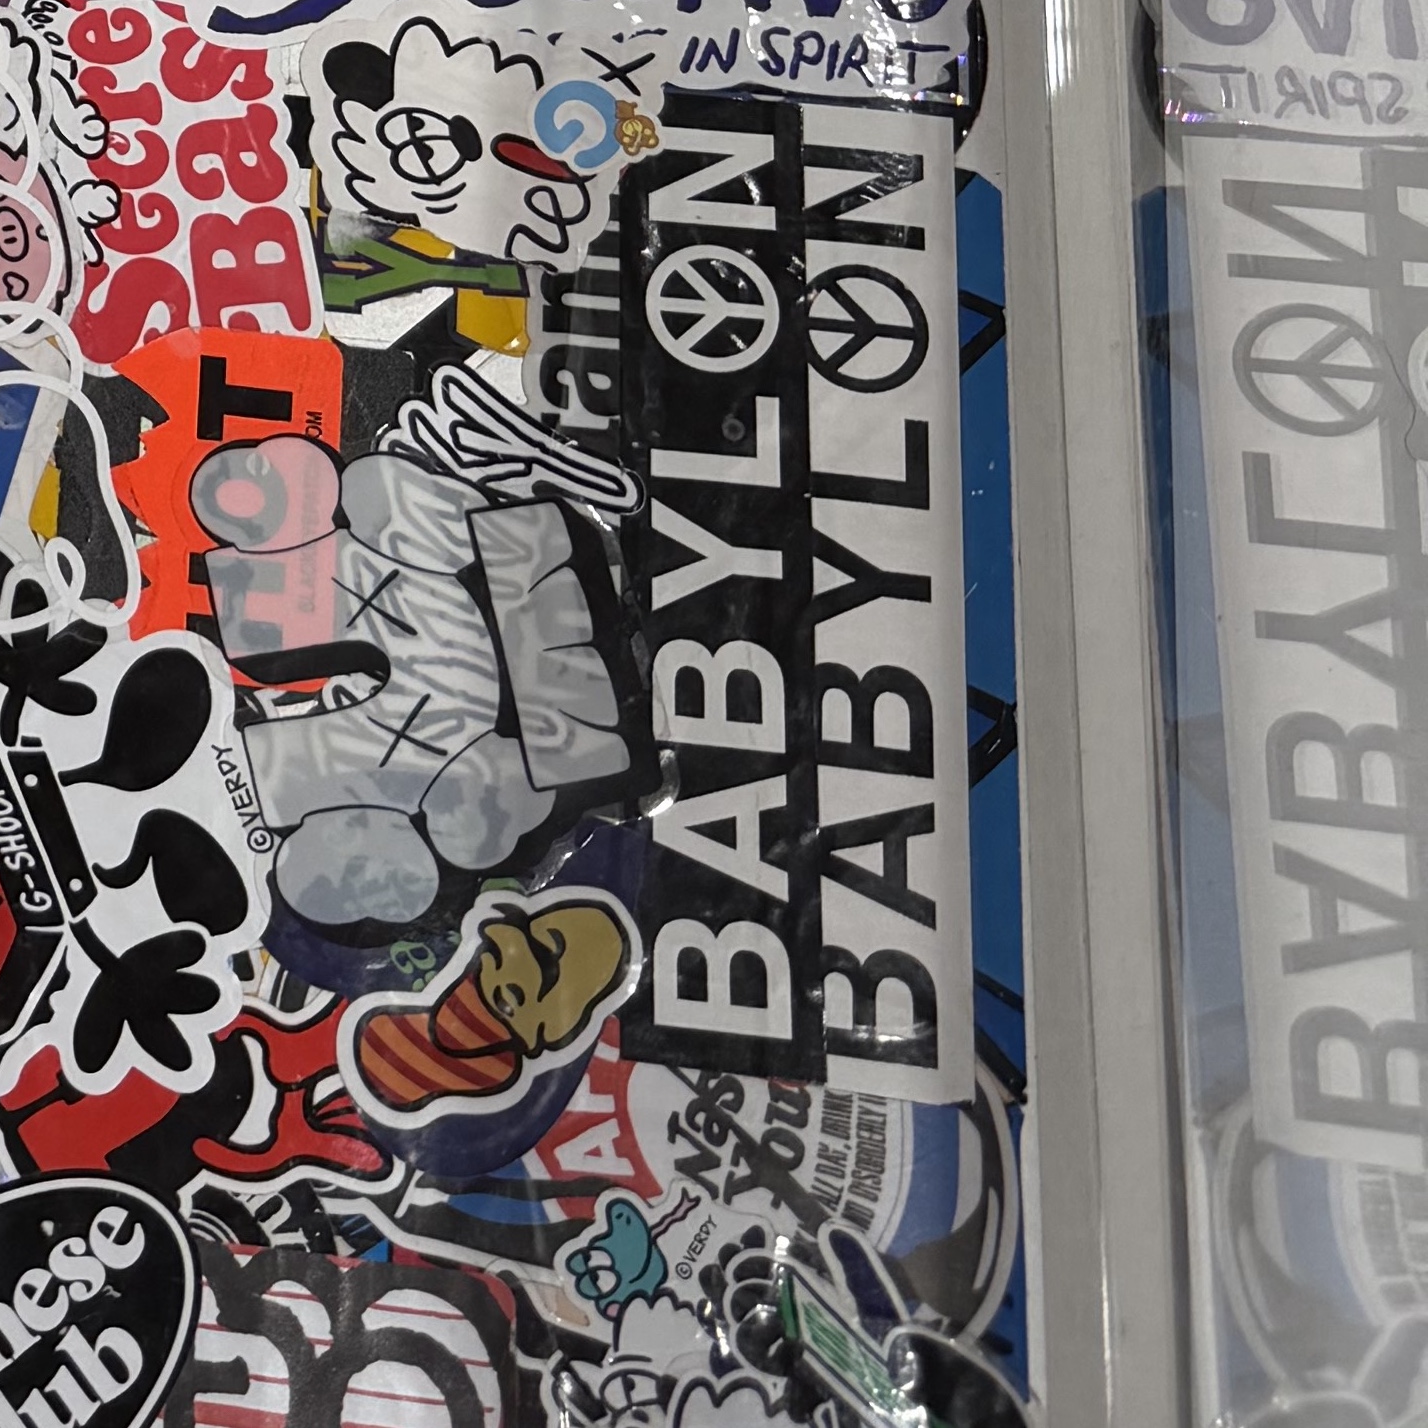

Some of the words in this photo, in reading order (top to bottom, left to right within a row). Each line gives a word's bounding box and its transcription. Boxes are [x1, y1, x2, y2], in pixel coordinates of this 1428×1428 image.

[680, 27, 741, 76] IN
[763, 27, 951, 88] SPIRIT
[159, 23, 312, 332] Bas
